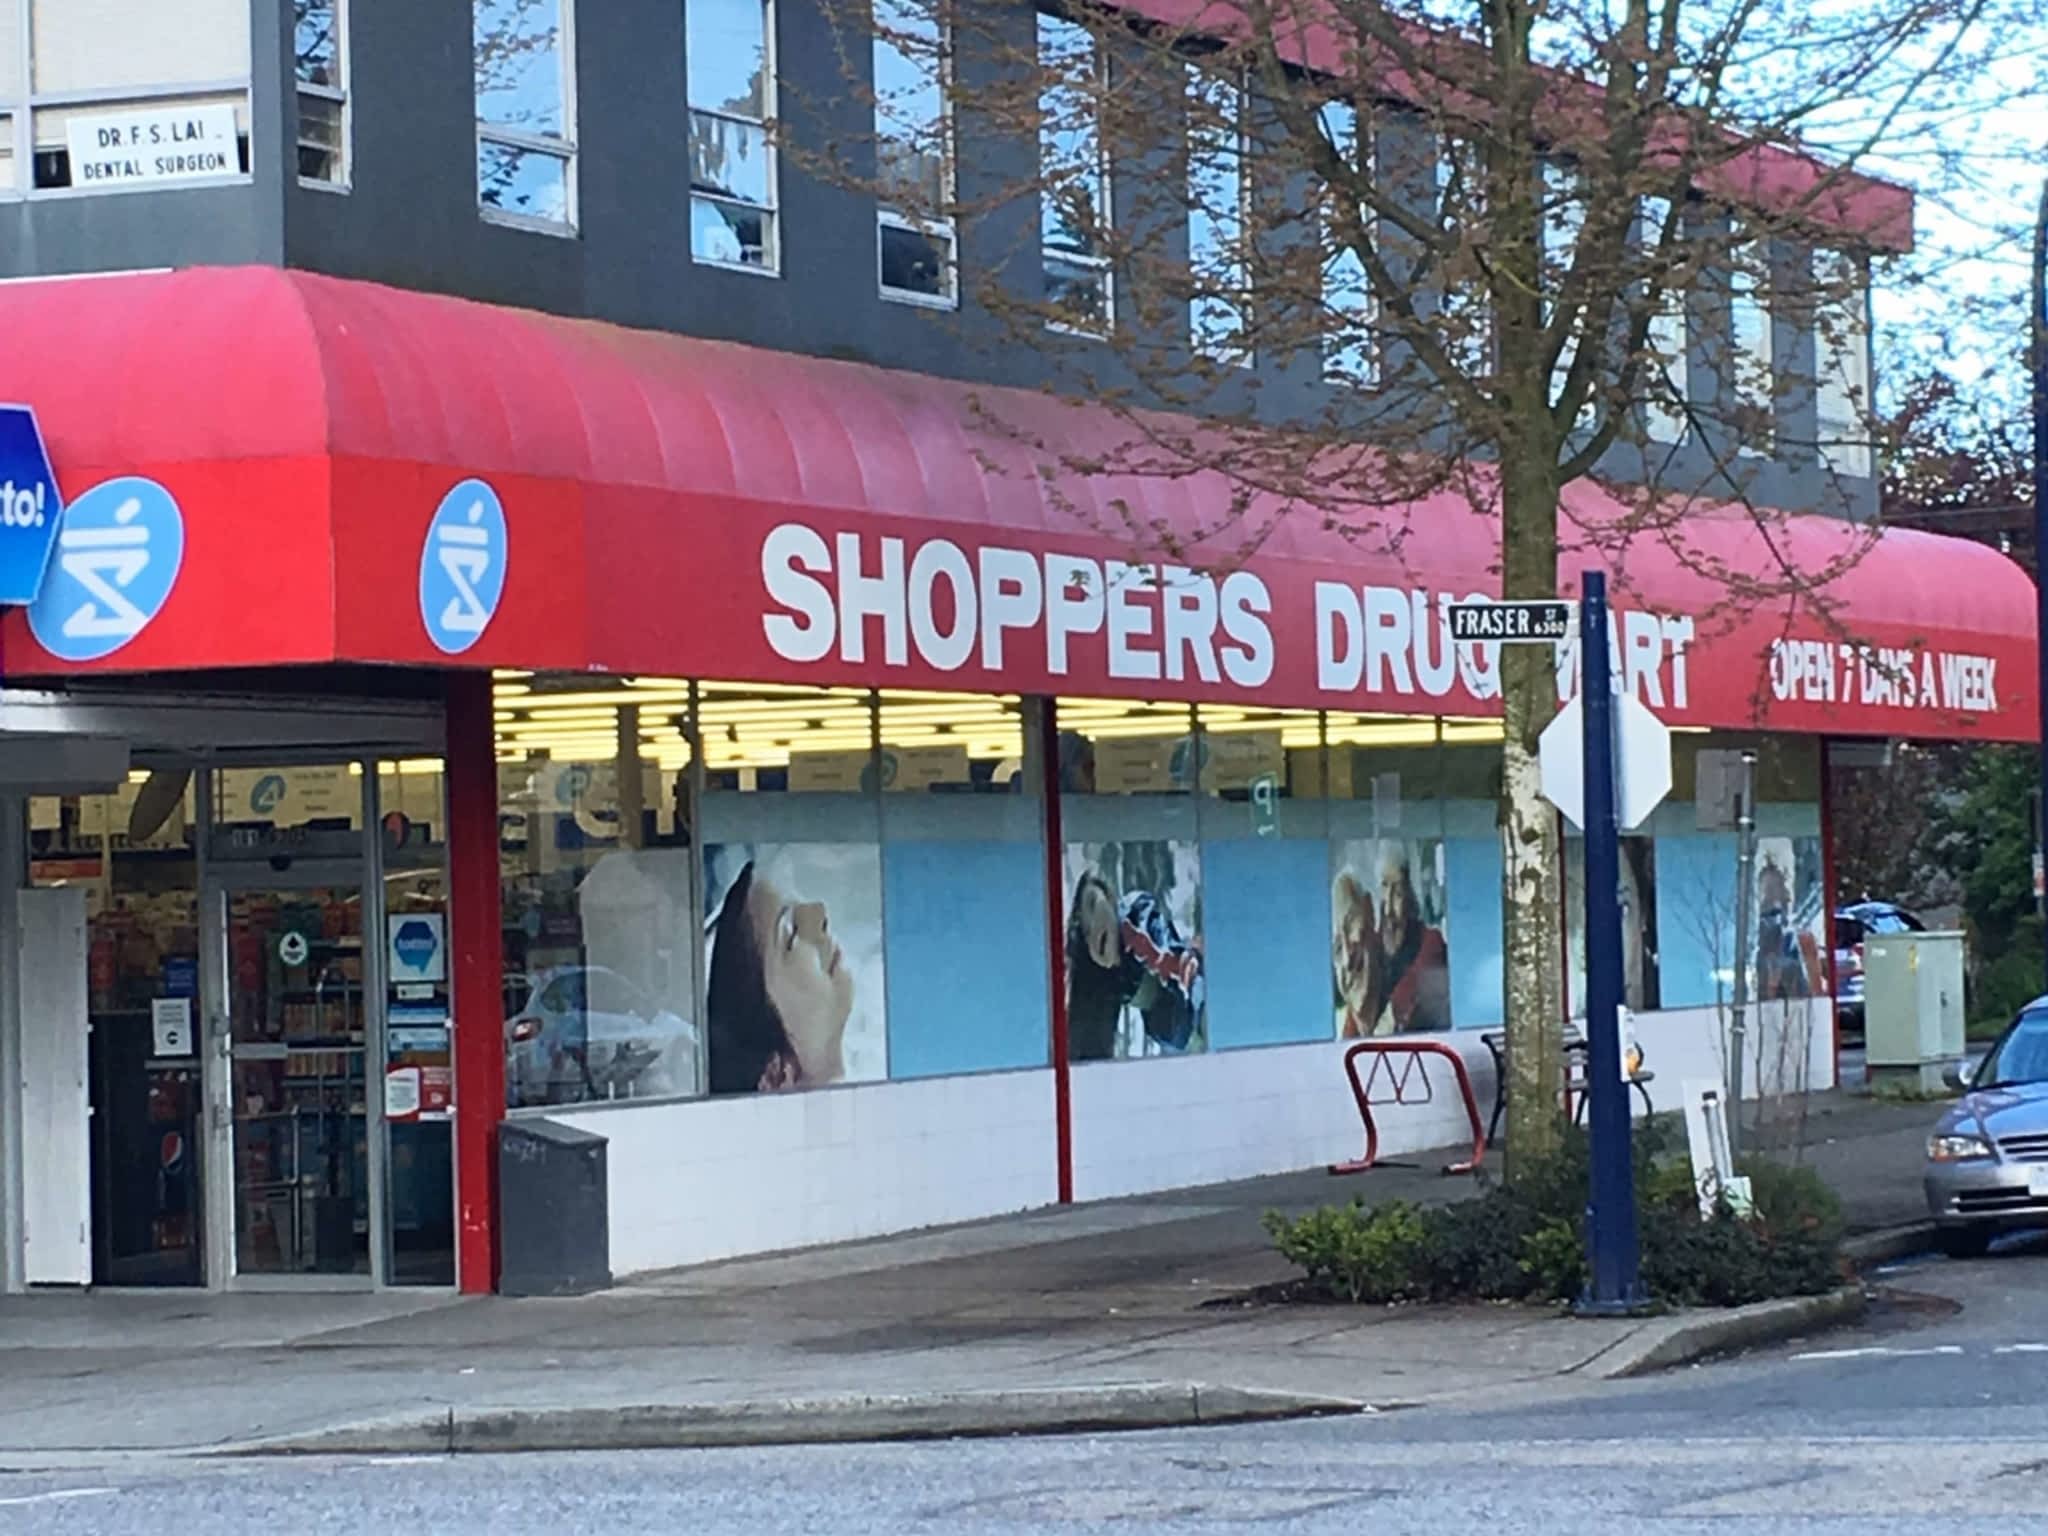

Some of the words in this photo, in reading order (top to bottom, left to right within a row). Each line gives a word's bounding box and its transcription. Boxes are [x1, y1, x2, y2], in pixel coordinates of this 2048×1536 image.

[84, 159, 144, 180] DENTAL
[155, 152, 227, 175] SURGEON
[0, 480, 45, 528] to!
[761, 523, 1275, 688] SHOPPERS
[1455, 608, 1530, 635] FRASER
[1544, 608, 1558, 621] ST
[1770, 637, 1835, 702] OPEN
[1839, 644, 1856, 703] 7
[1859, 646, 1917, 708] DAYS
[1920, 651, 1938, 708] A
[1939, 652, 1998, 711] WEEK
